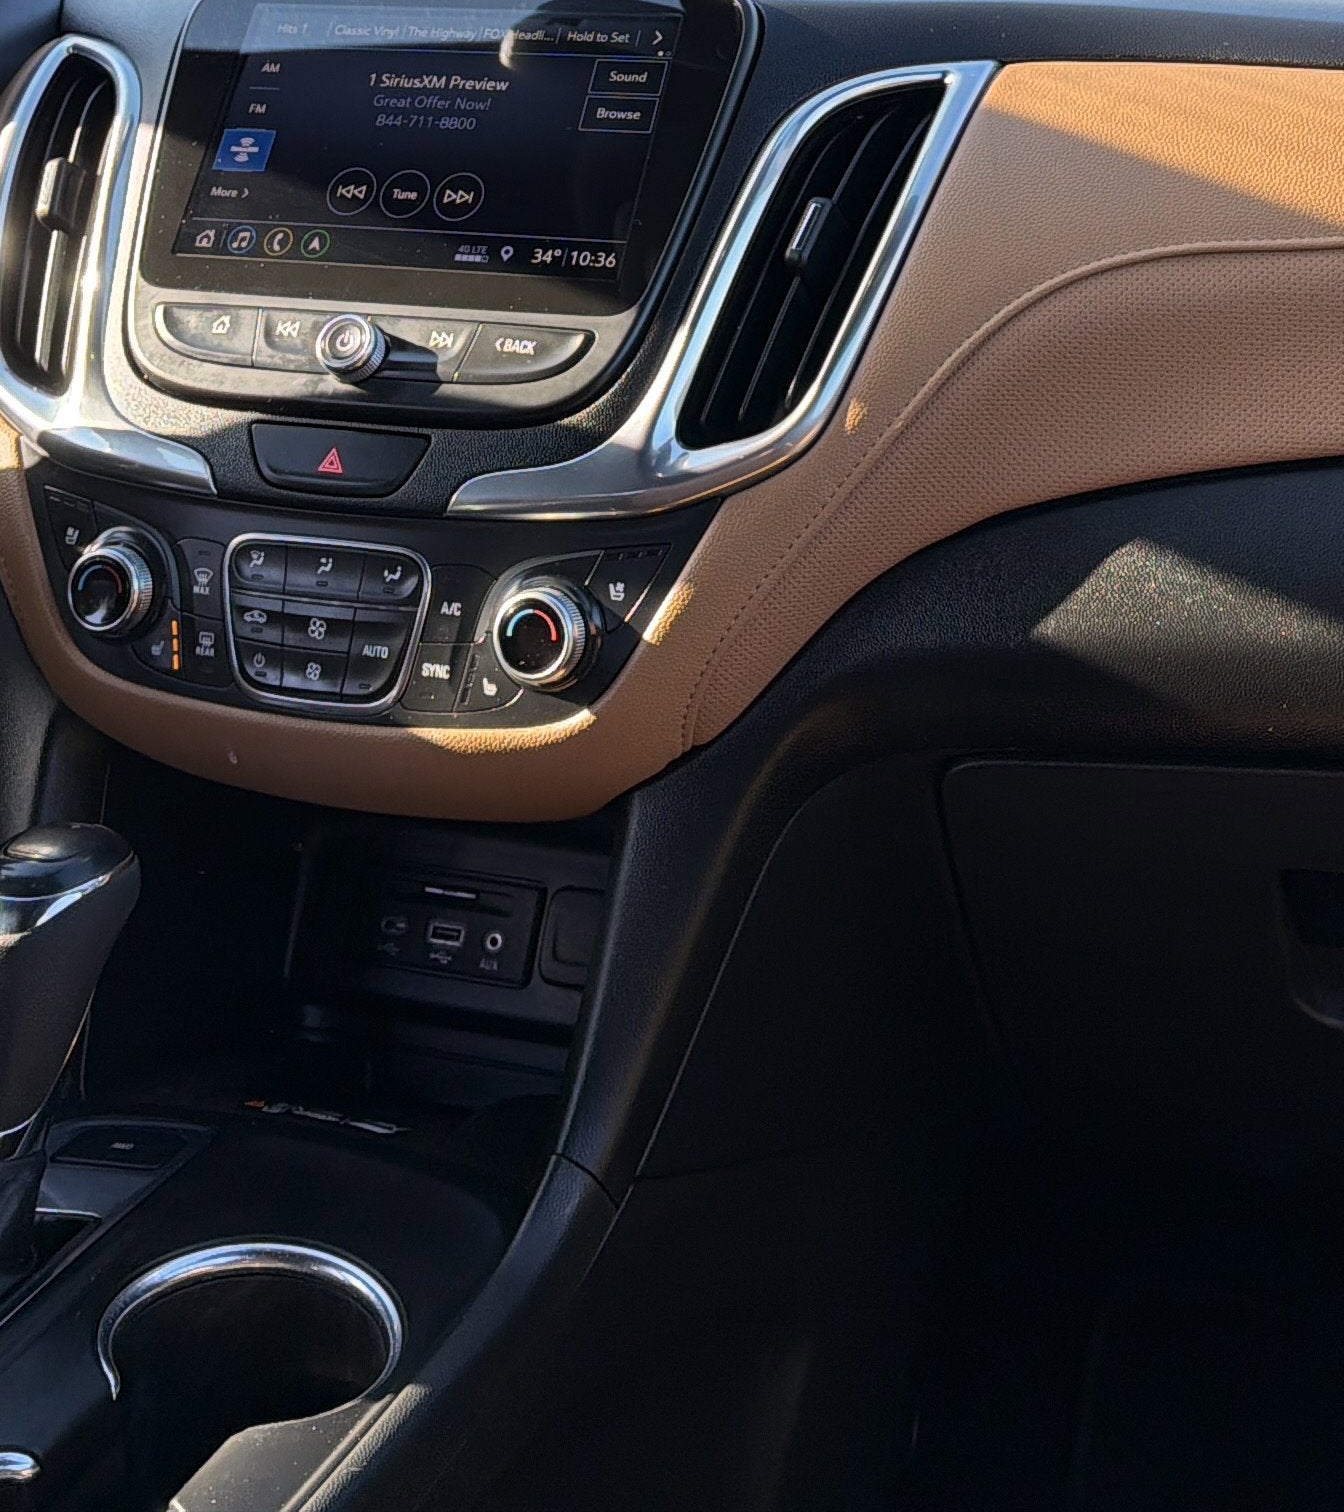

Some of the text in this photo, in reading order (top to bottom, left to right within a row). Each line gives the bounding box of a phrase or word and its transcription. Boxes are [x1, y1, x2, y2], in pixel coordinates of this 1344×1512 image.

[334, 24, 401, 39] Classic Vinyl
[408, 26, 477, 42] The Highway
[567, 30, 631, 43] Hold to Set
[261, 62, 281, 73] AM
[369, 73, 510, 92] 1 SiriusXM Preview
[609, 70, 648, 83] Sound
[248, 103, 267, 114] FM
[373, 94, 492, 111] Great Offer Now!
[376, 113, 477, 130] 844-711-8800
[596, 107, 641, 121] Browse
[210, 186, 239, 198] More
[392, 188, 418, 200] Tune
[472, 245, 489, 255] LTE
[531, 248, 562, 264] 34°
[570, 250, 616, 268] 10:36
[503, 338, 537, 356] BACK
[192, 585, 210, 596] MAX
[440, 601, 462, 617] A/C
[194, 646, 216, 658] REAR
[361, 644, 390, 659] AUTO
[421, 662, 451, 680] SYNC
